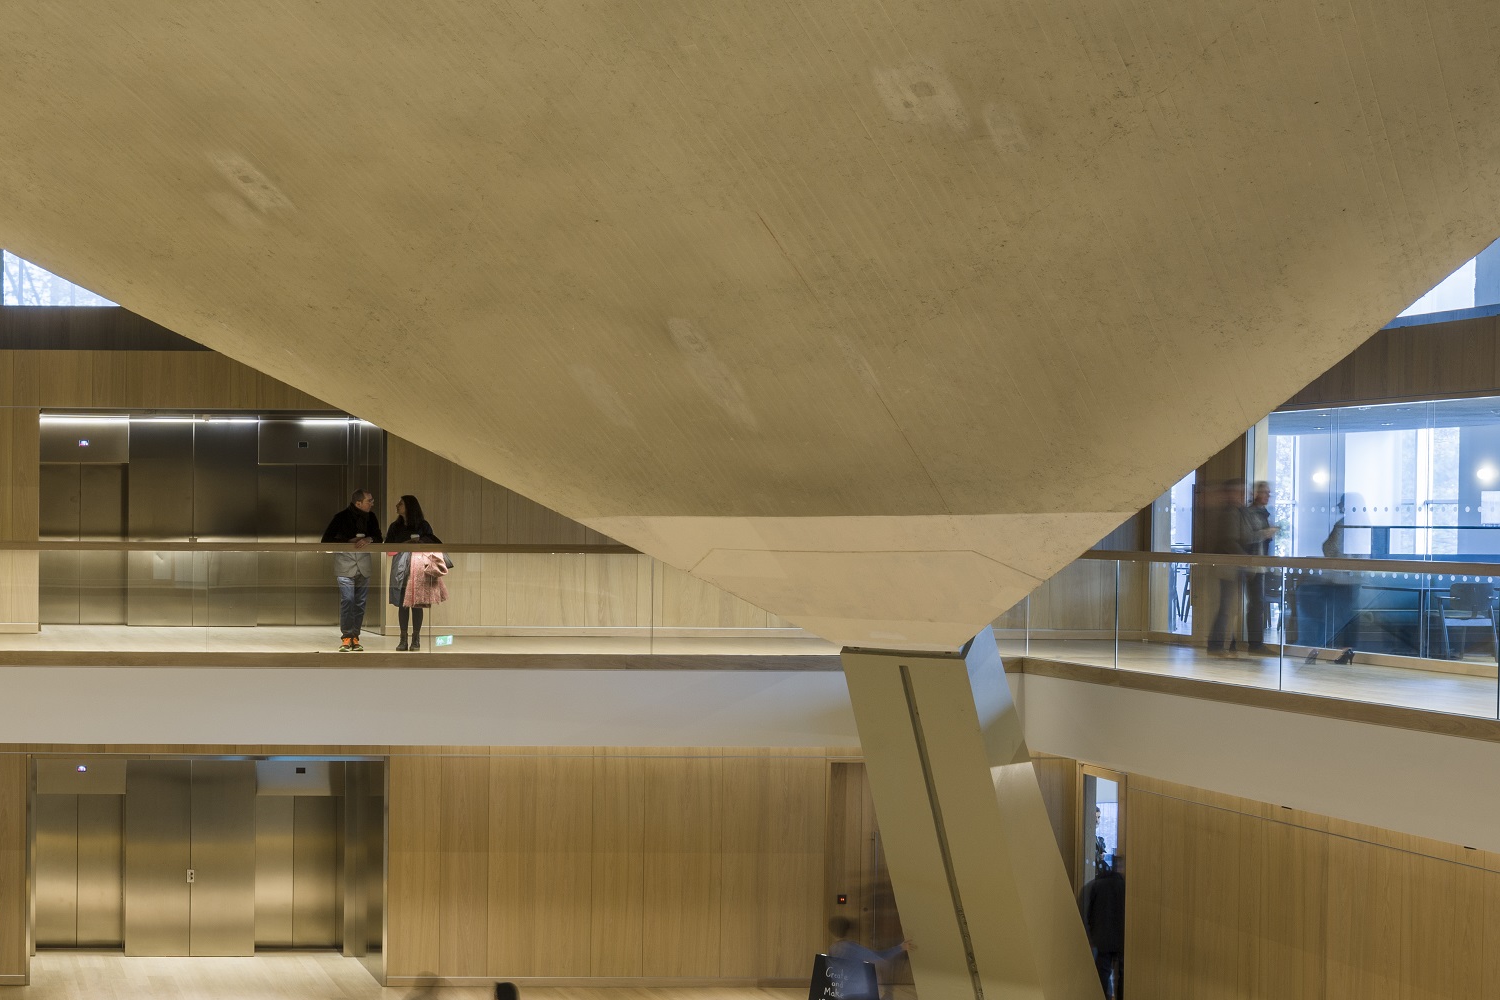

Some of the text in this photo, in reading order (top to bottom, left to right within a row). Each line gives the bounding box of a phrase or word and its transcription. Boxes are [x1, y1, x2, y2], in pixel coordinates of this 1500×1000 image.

[825, 966, 849, 981] Create
[831, 980, 844, 989] and
[823, 987, 845, 999] Make
